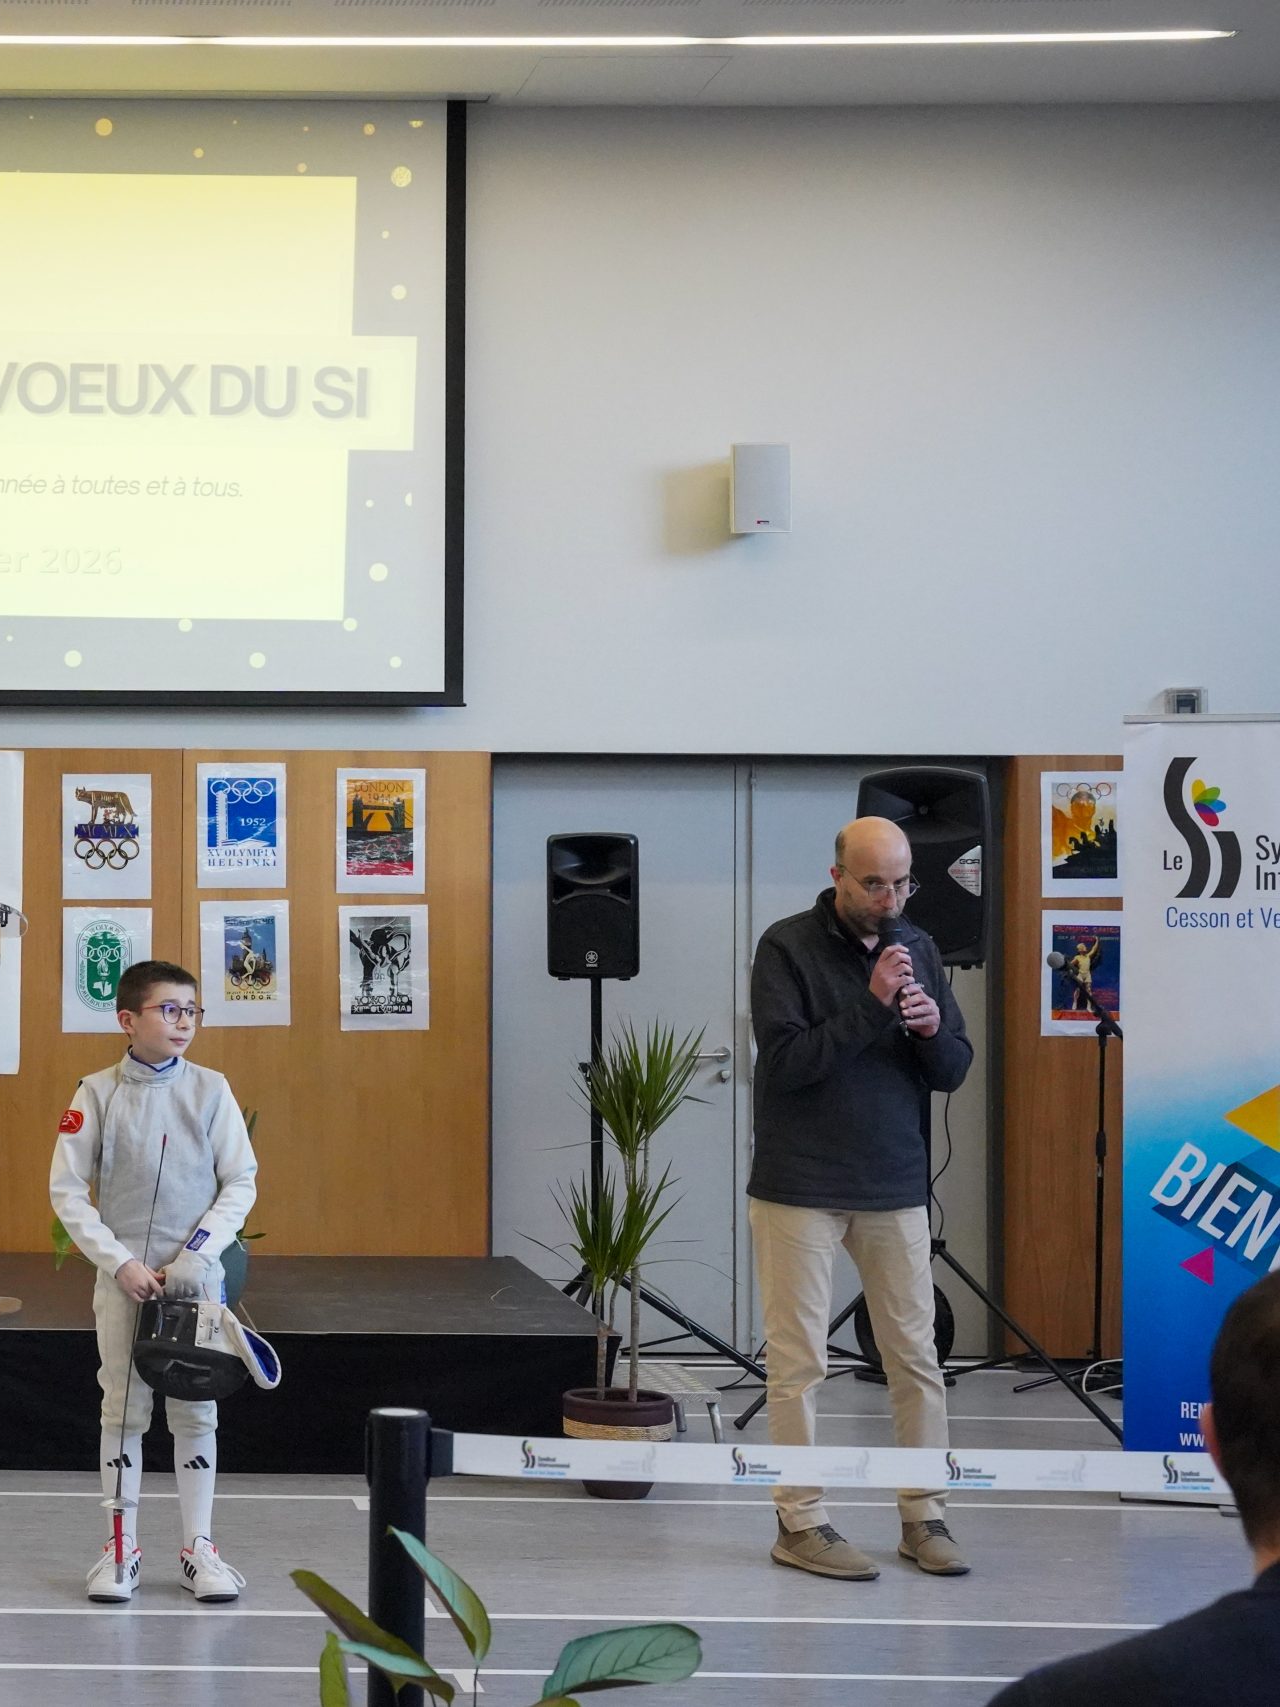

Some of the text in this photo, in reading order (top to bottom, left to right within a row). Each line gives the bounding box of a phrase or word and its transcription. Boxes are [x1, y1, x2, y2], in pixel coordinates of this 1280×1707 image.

[209, 364, 298, 418] DU
[311, 366, 369, 419] SI
[51, 474, 65, 495] à
[71, 475, 141, 496] toutes
[145, 476, 168, 496] et
[172, 475, 186, 497] à
[192, 476, 244, 498] tous.
[39, 546, 123, 576] 2026
[240, 817, 267, 827] 1952
[208, 858, 277, 867] HELSINKI
[224, 848, 277, 857] OLYMPIA
[1163, 850, 1183, 871] Le
[1166, 906, 1230, 928] Cesson
[1236, 908, 1254, 928] et
[1150, 1142, 1280, 1273] BIEN
